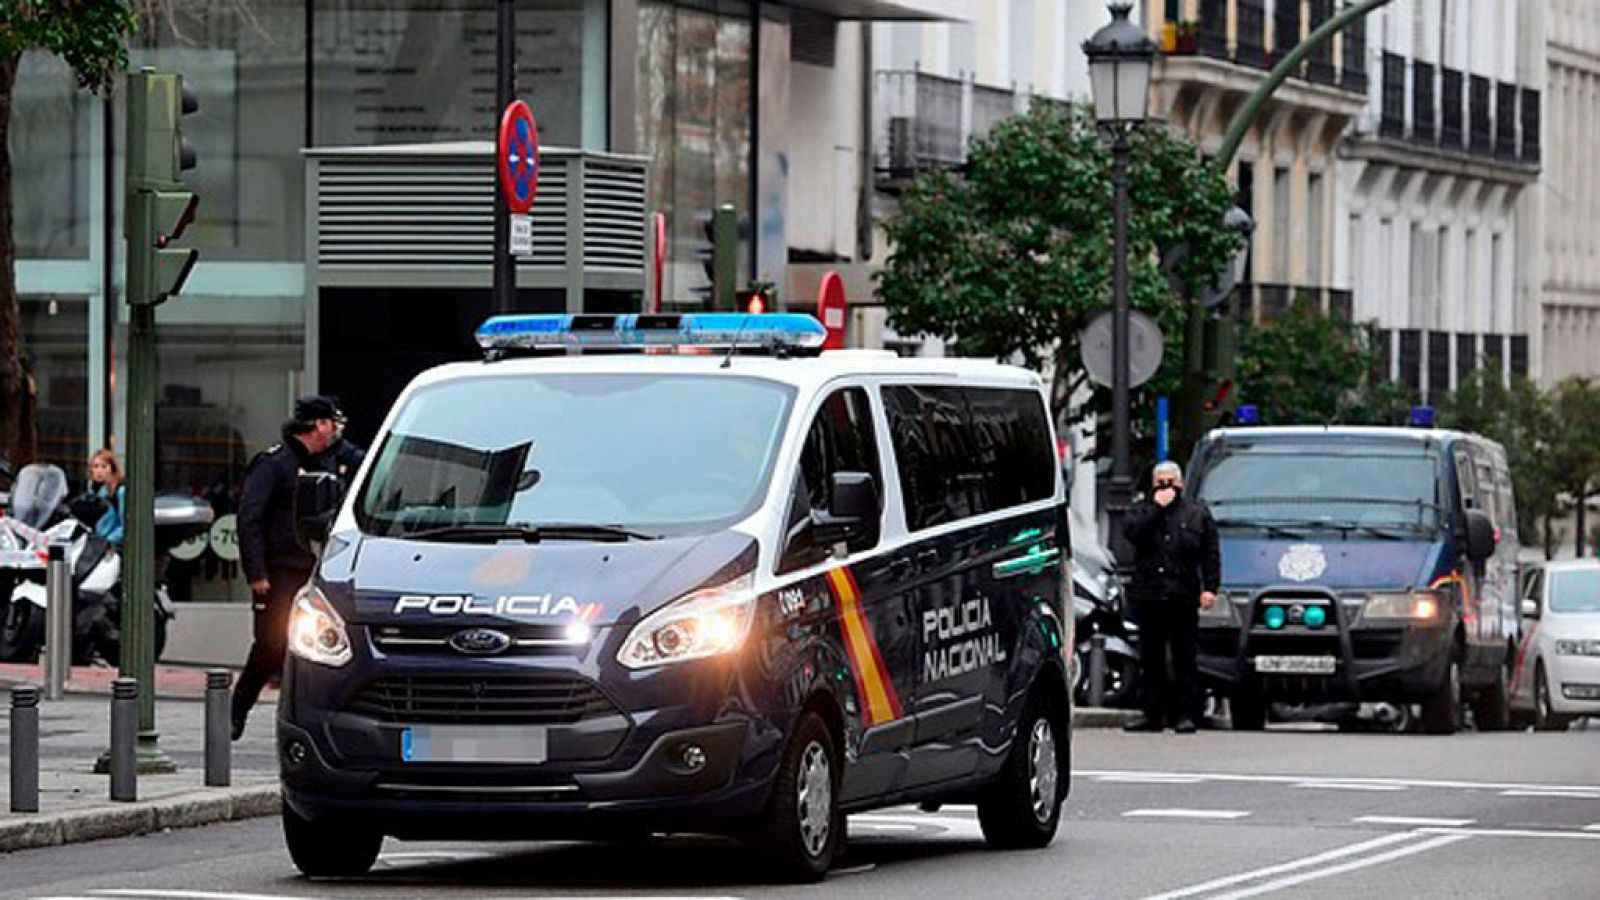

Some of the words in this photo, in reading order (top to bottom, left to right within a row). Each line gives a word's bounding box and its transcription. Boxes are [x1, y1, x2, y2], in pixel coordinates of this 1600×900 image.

[394, 593, 580, 616] POLICÍA
[922, 590, 993, 643] POLICÍA
[922, 632, 1007, 684] NACIONAL
